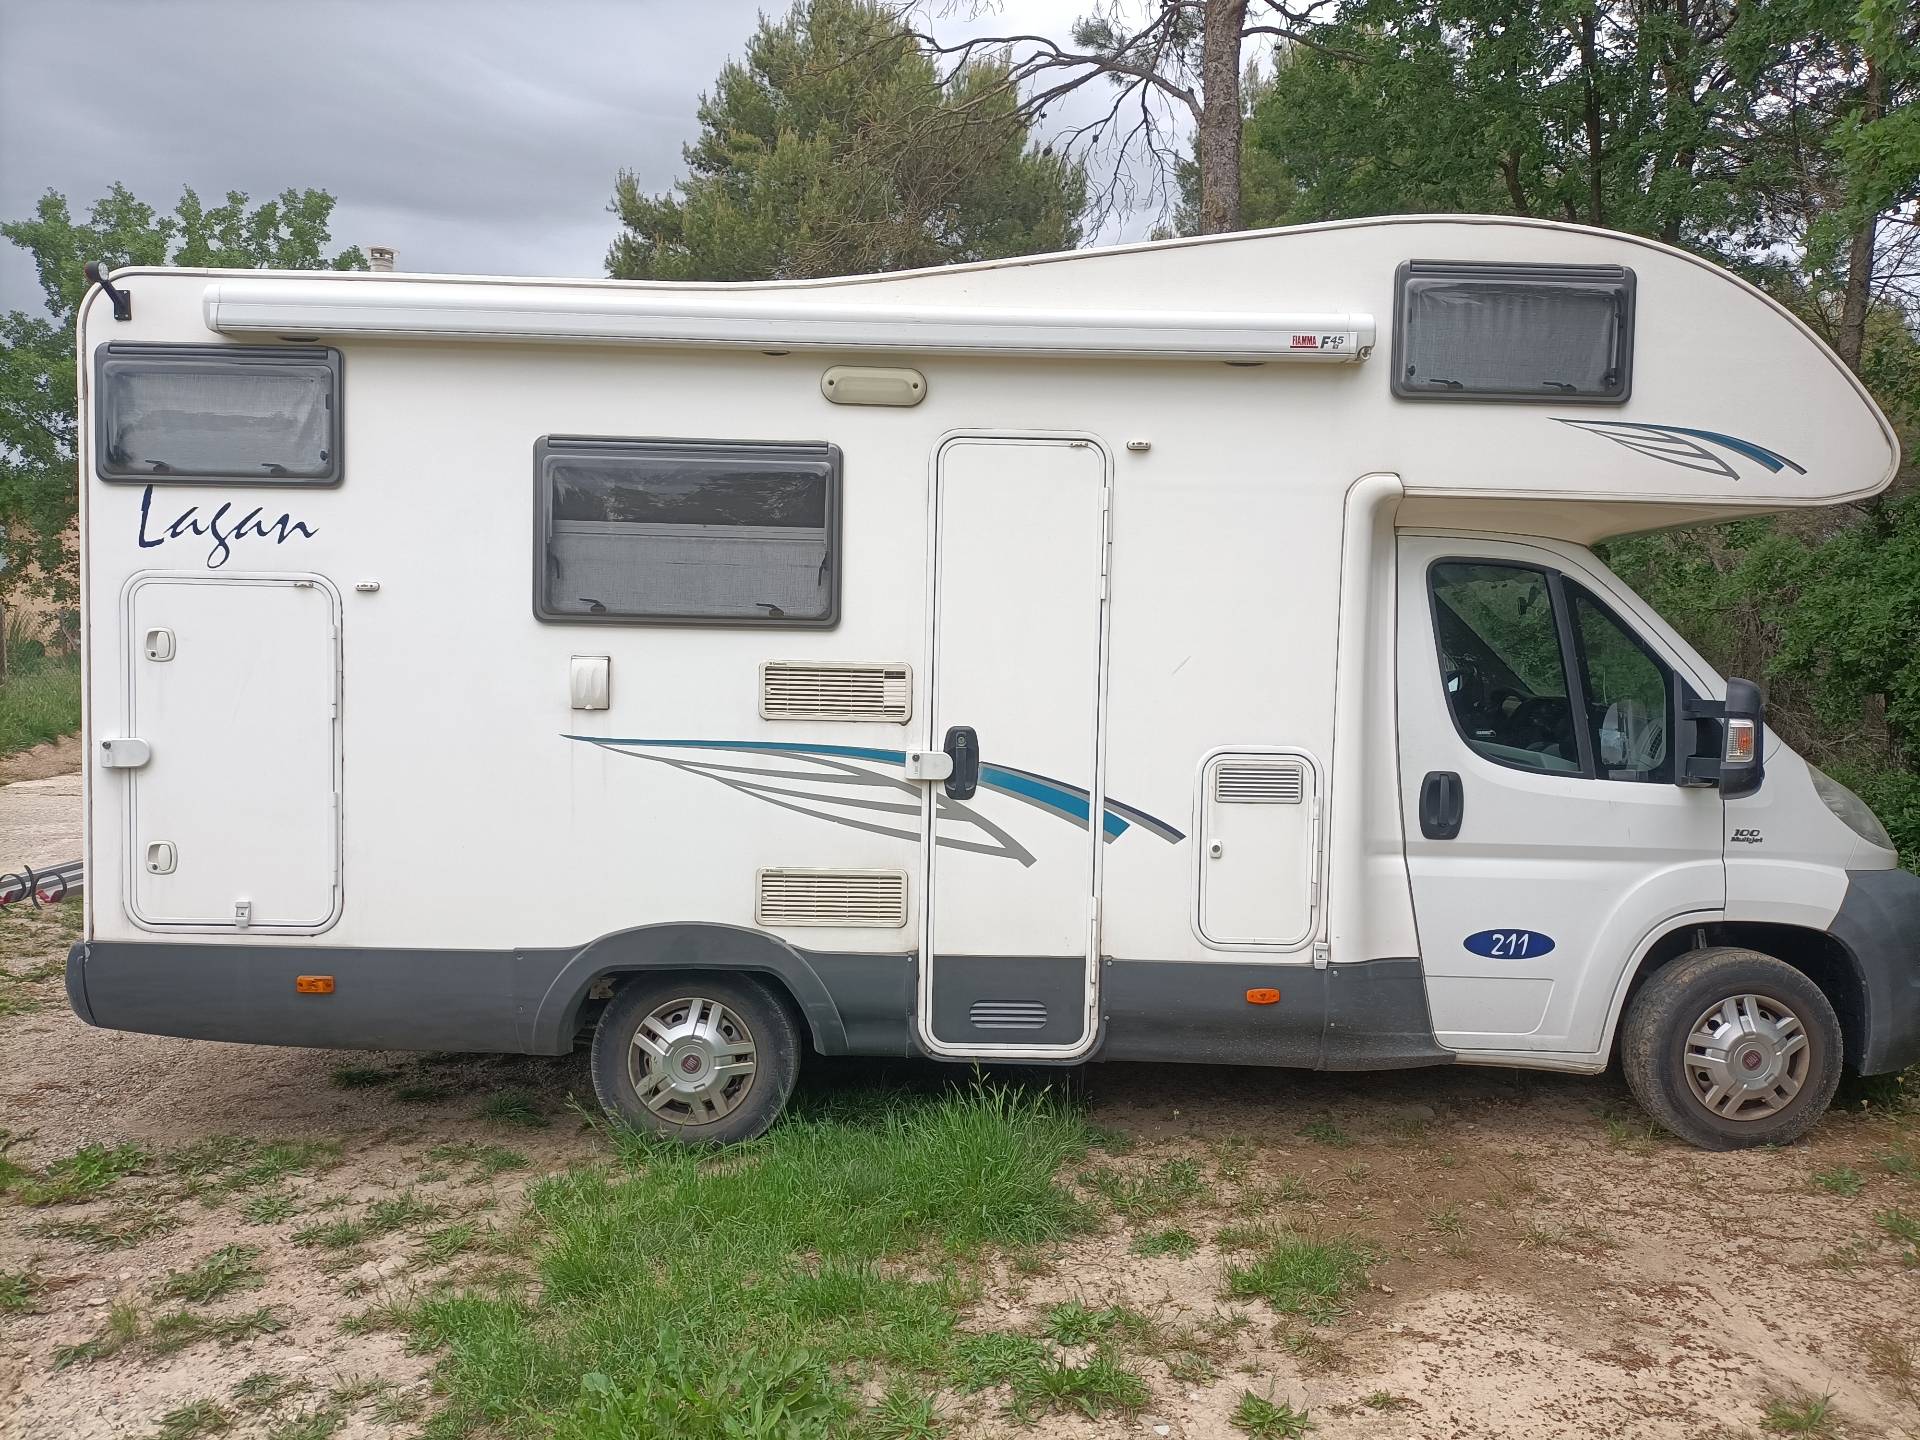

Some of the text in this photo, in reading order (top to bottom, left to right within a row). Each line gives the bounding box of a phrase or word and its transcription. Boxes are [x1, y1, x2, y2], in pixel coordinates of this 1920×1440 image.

[1292, 335, 1318, 346] FIAMMA
[138, 484, 320, 569] Lagan
[1734, 829, 1761, 837] 100
[1490, 933, 1529, 956] 211
